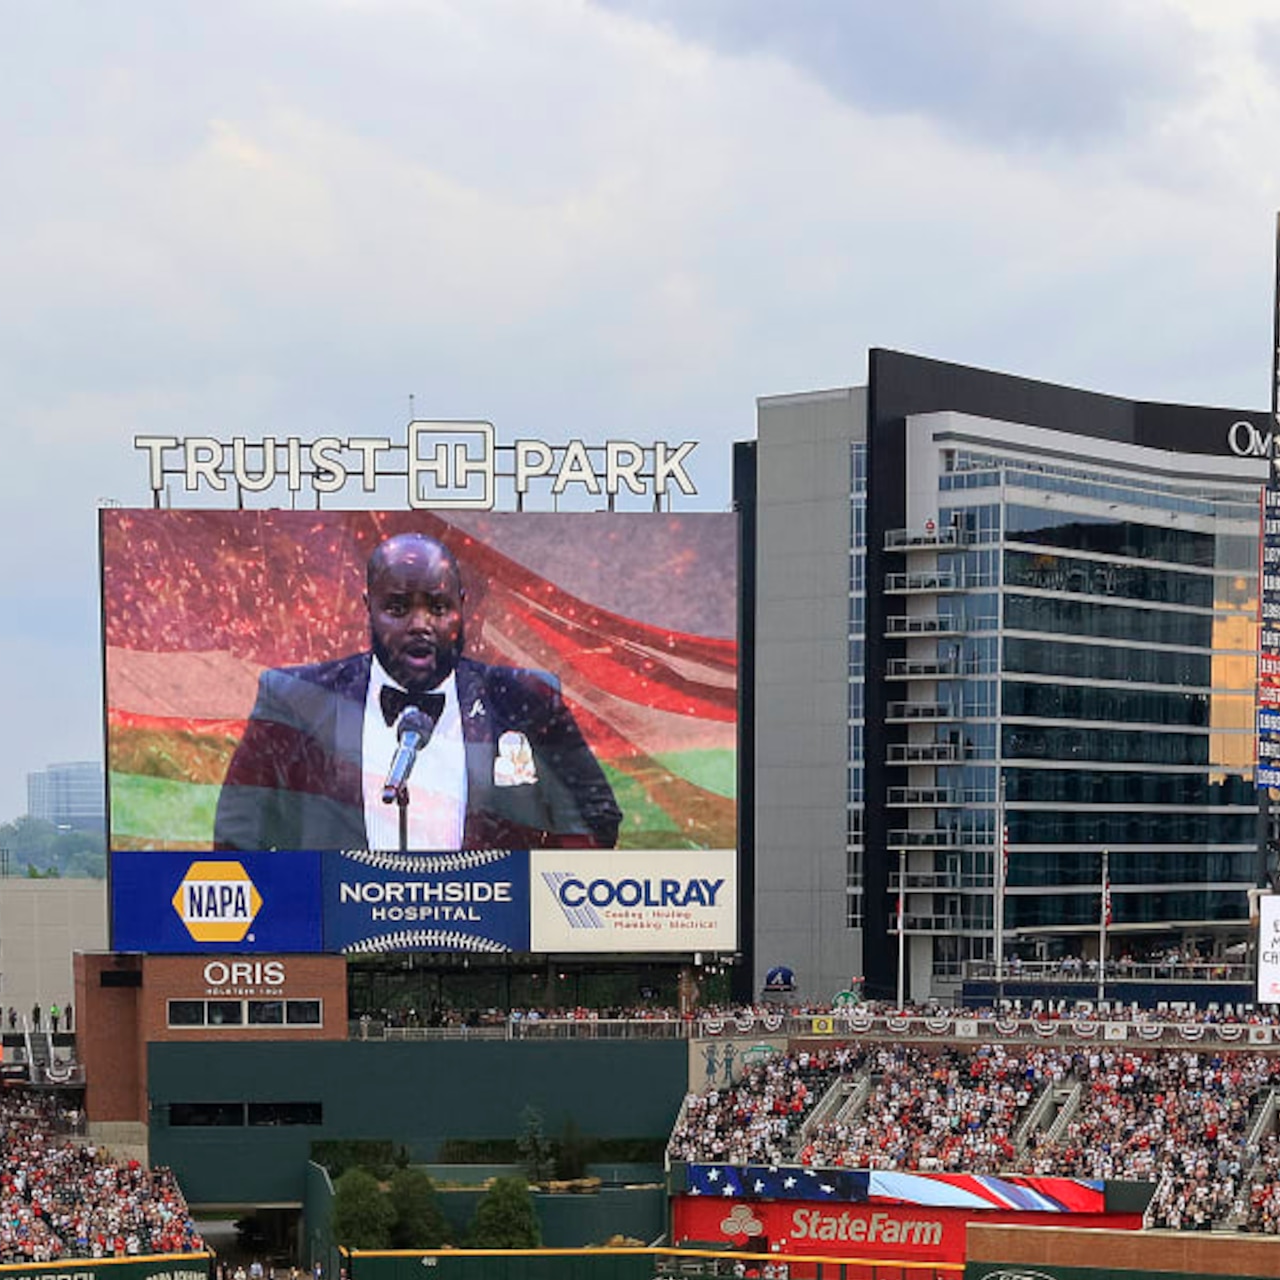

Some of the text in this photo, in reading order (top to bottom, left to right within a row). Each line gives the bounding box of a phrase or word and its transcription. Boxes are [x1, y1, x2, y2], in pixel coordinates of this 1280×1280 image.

[134, 435, 700, 495] TRUIST PARK
[185, 884, 251, 919] NAPA
[339, 881, 513, 903] NORTHSIDE
[559, 879, 726, 908] COOLRAY
[371, 905, 482, 921] HOSPITAL
[203, 961, 287, 986] ORIS
